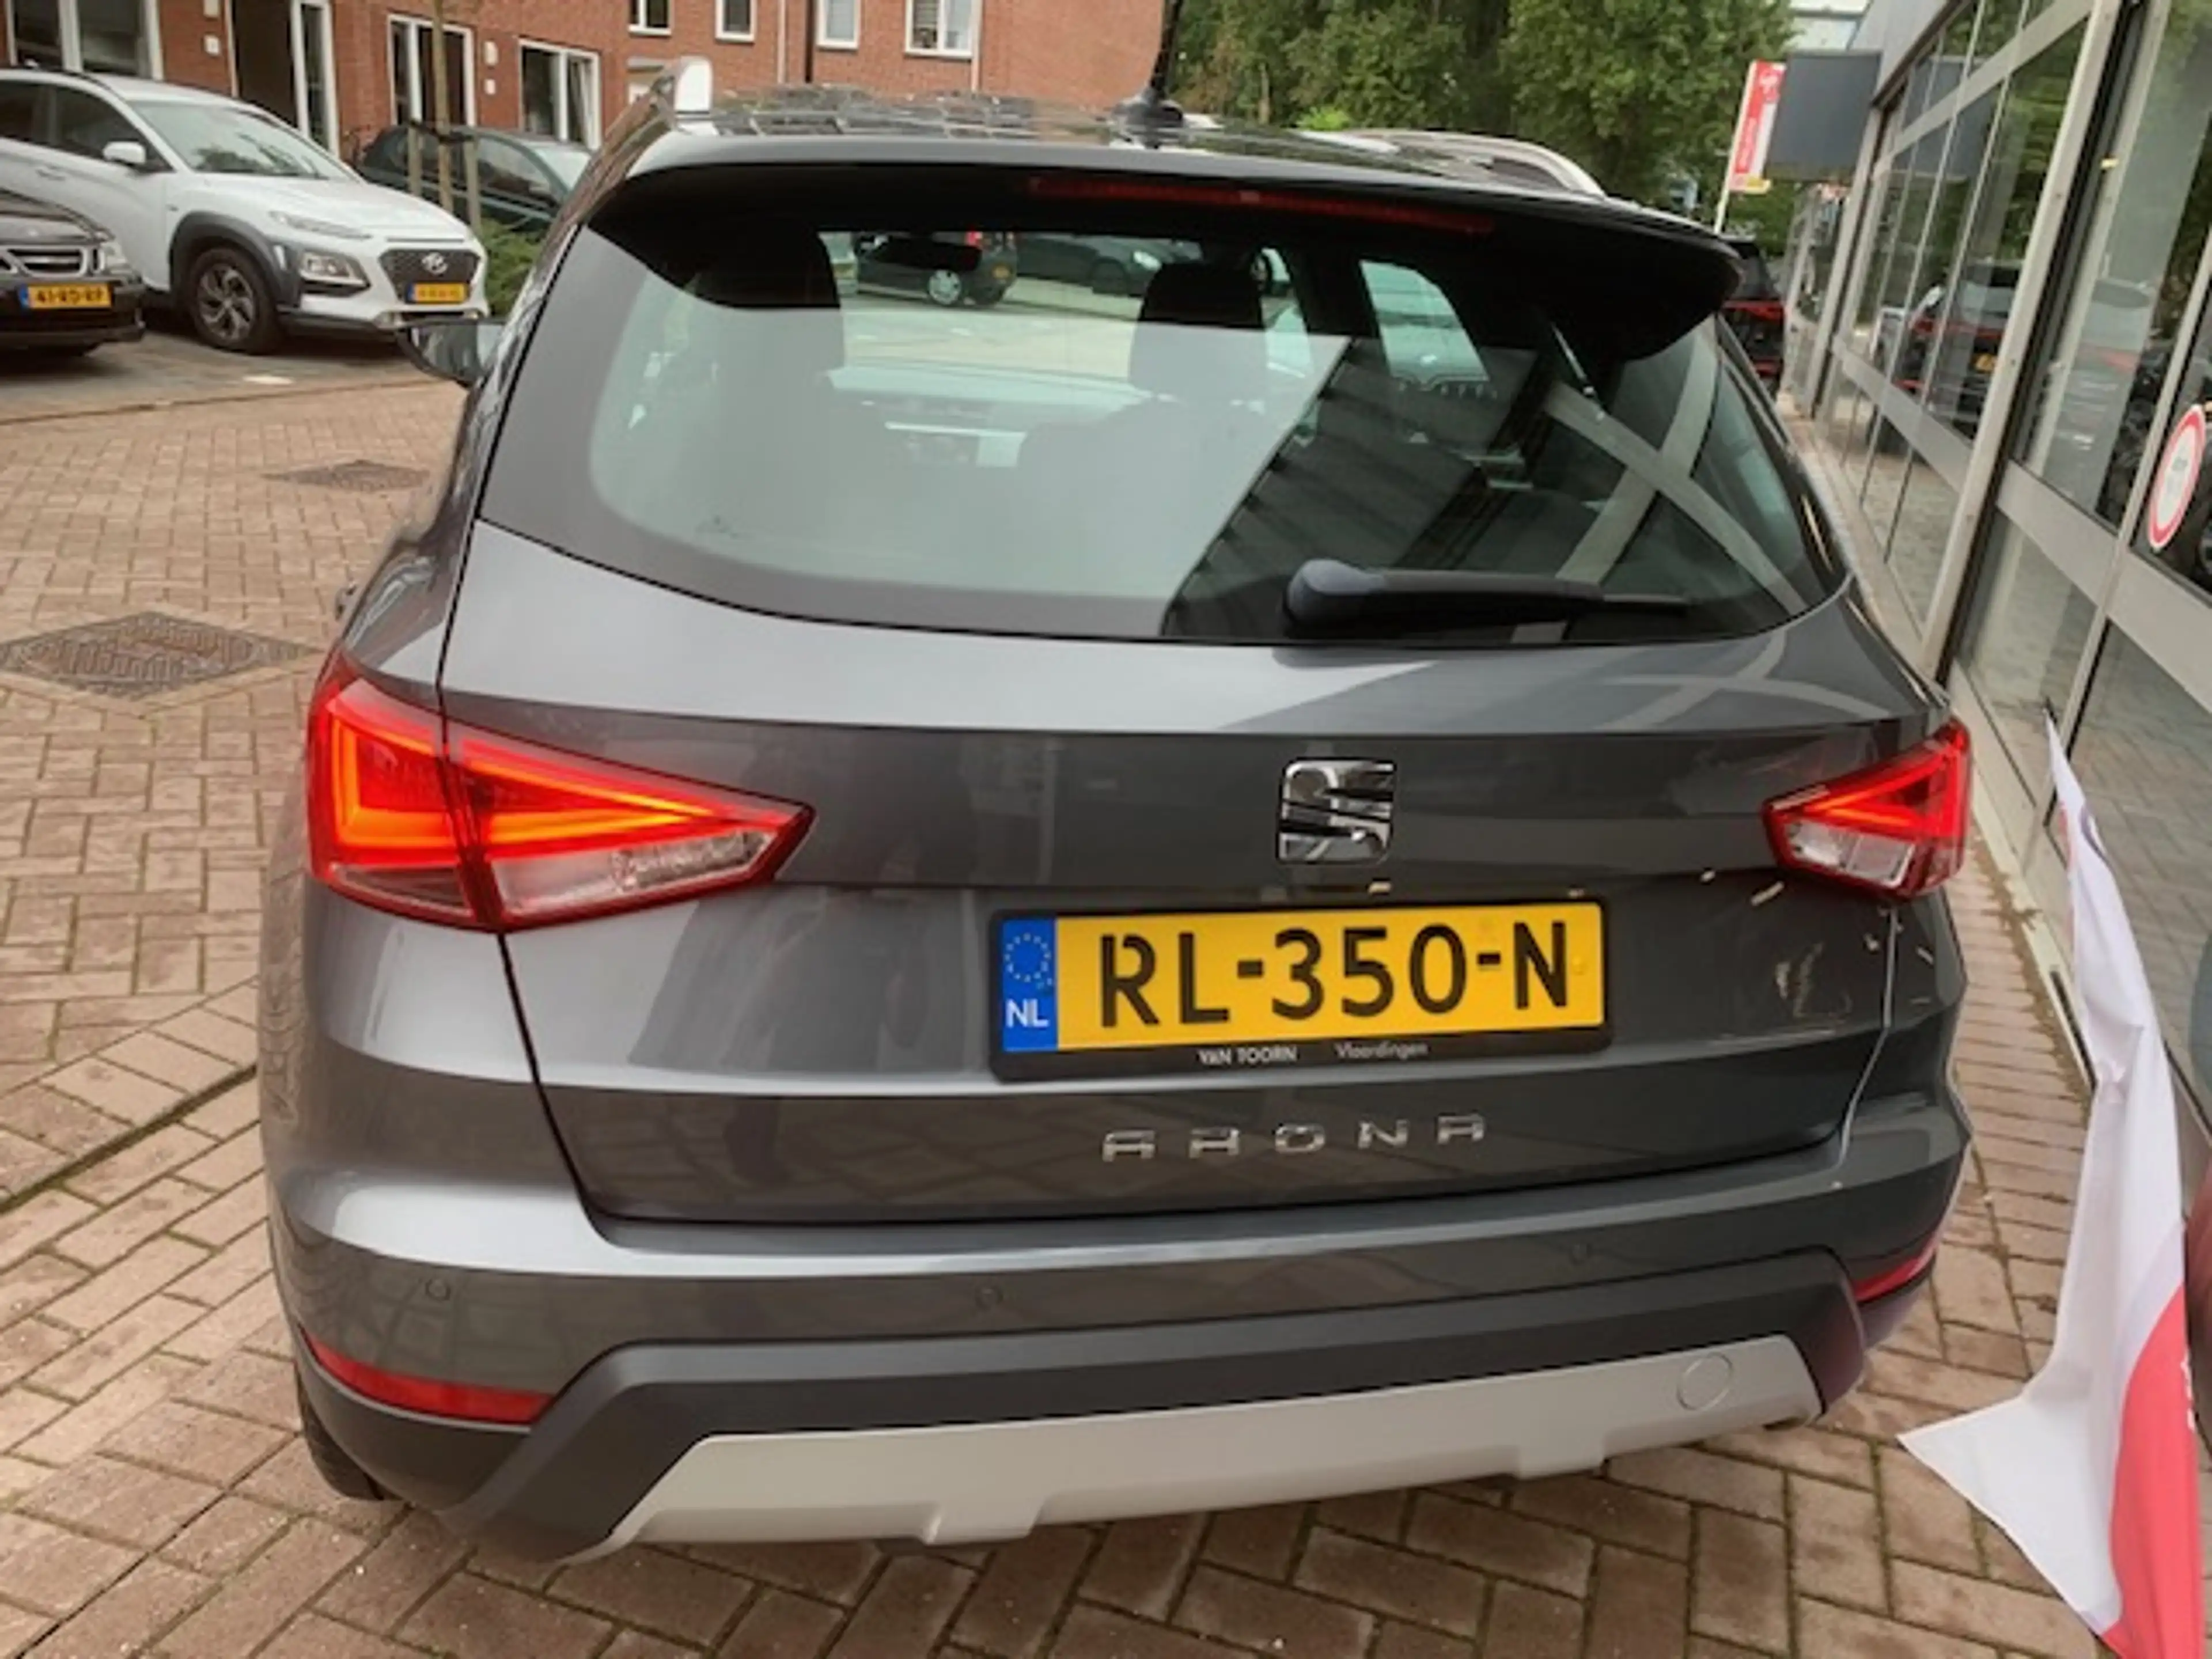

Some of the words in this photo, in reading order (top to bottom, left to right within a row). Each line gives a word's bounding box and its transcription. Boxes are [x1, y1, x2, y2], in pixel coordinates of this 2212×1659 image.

[1100, 921, 1567, 1028] RL-350-N
[1006, 999, 1049, 1027] NL
[1198, 1048, 1232, 1065] VAN
[1237, 1044, 1298, 1065] TOORN
[1103, 1113, 1484, 1162] ARONA
